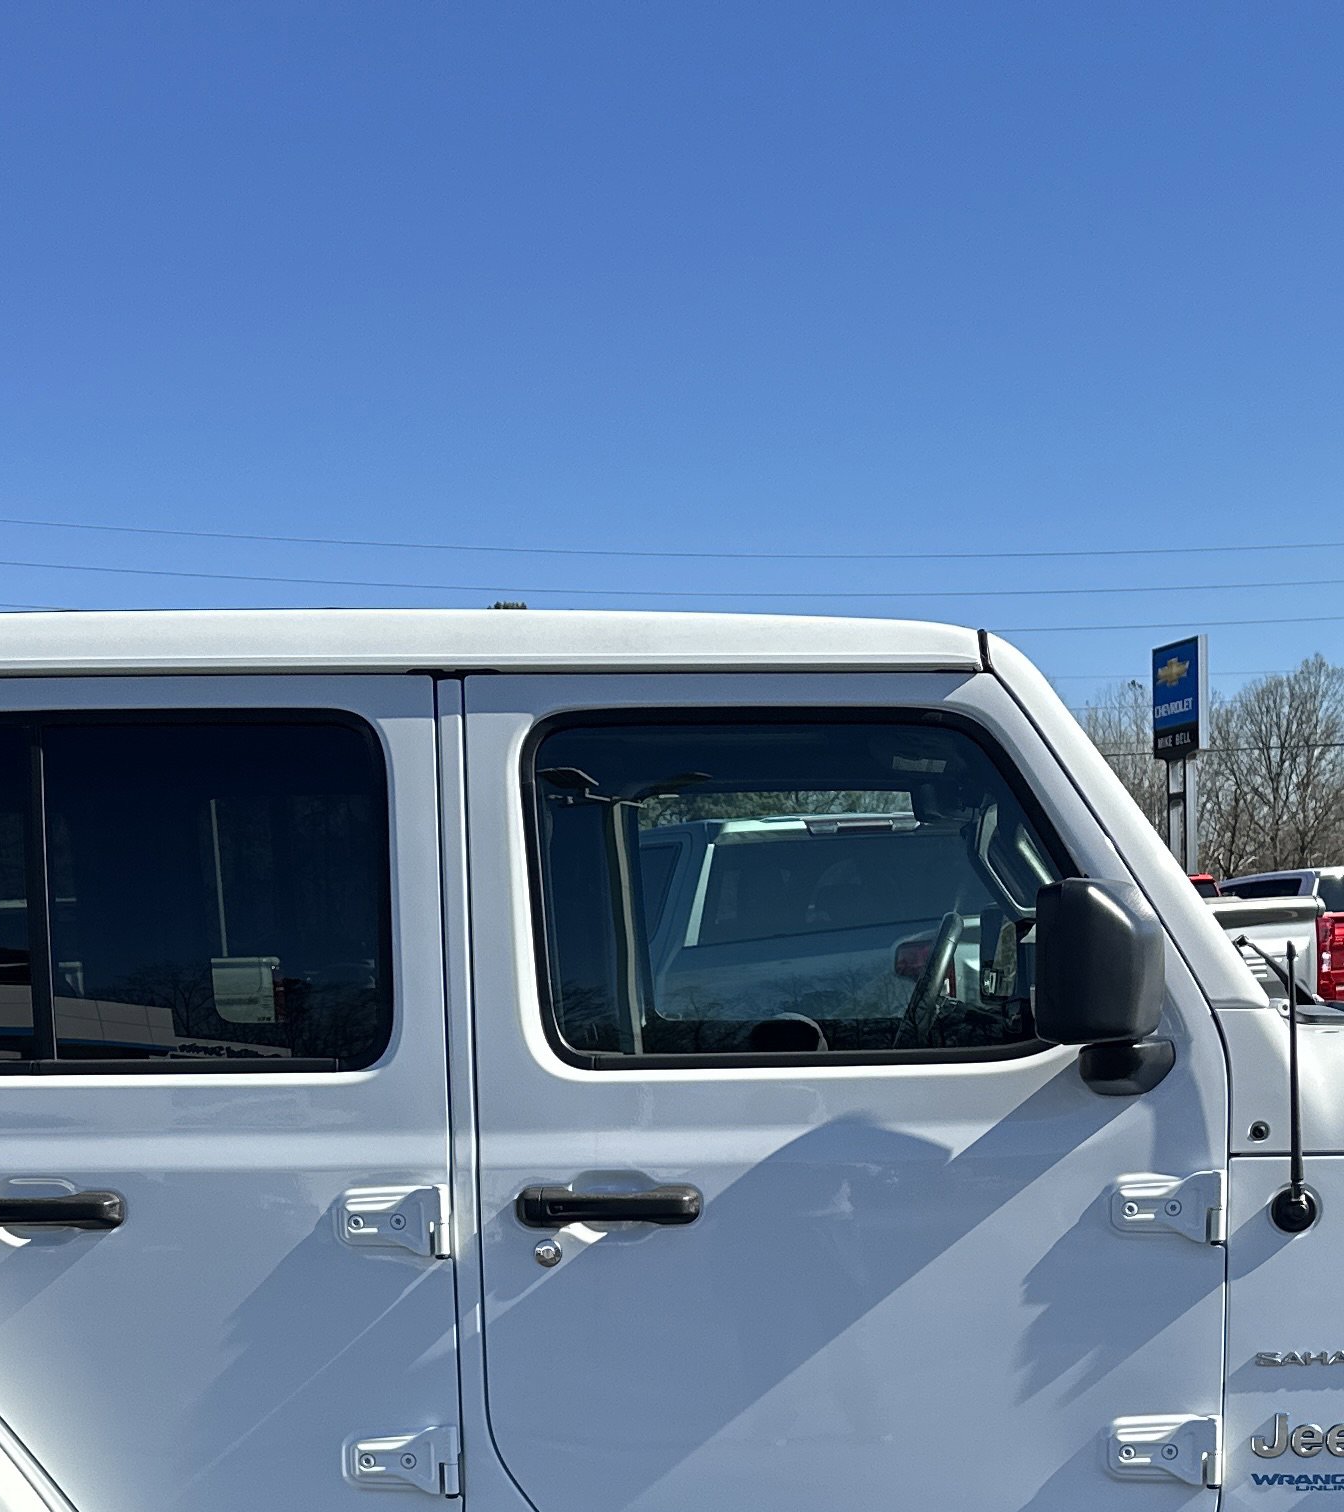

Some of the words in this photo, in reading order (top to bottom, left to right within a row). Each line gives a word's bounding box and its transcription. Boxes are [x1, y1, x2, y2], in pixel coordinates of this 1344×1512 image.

[1155, 697, 1193, 719] CHEVROLET
[1157, 735, 1173, 749] MIKE
[1175, 732, 1191, 746] BELL
